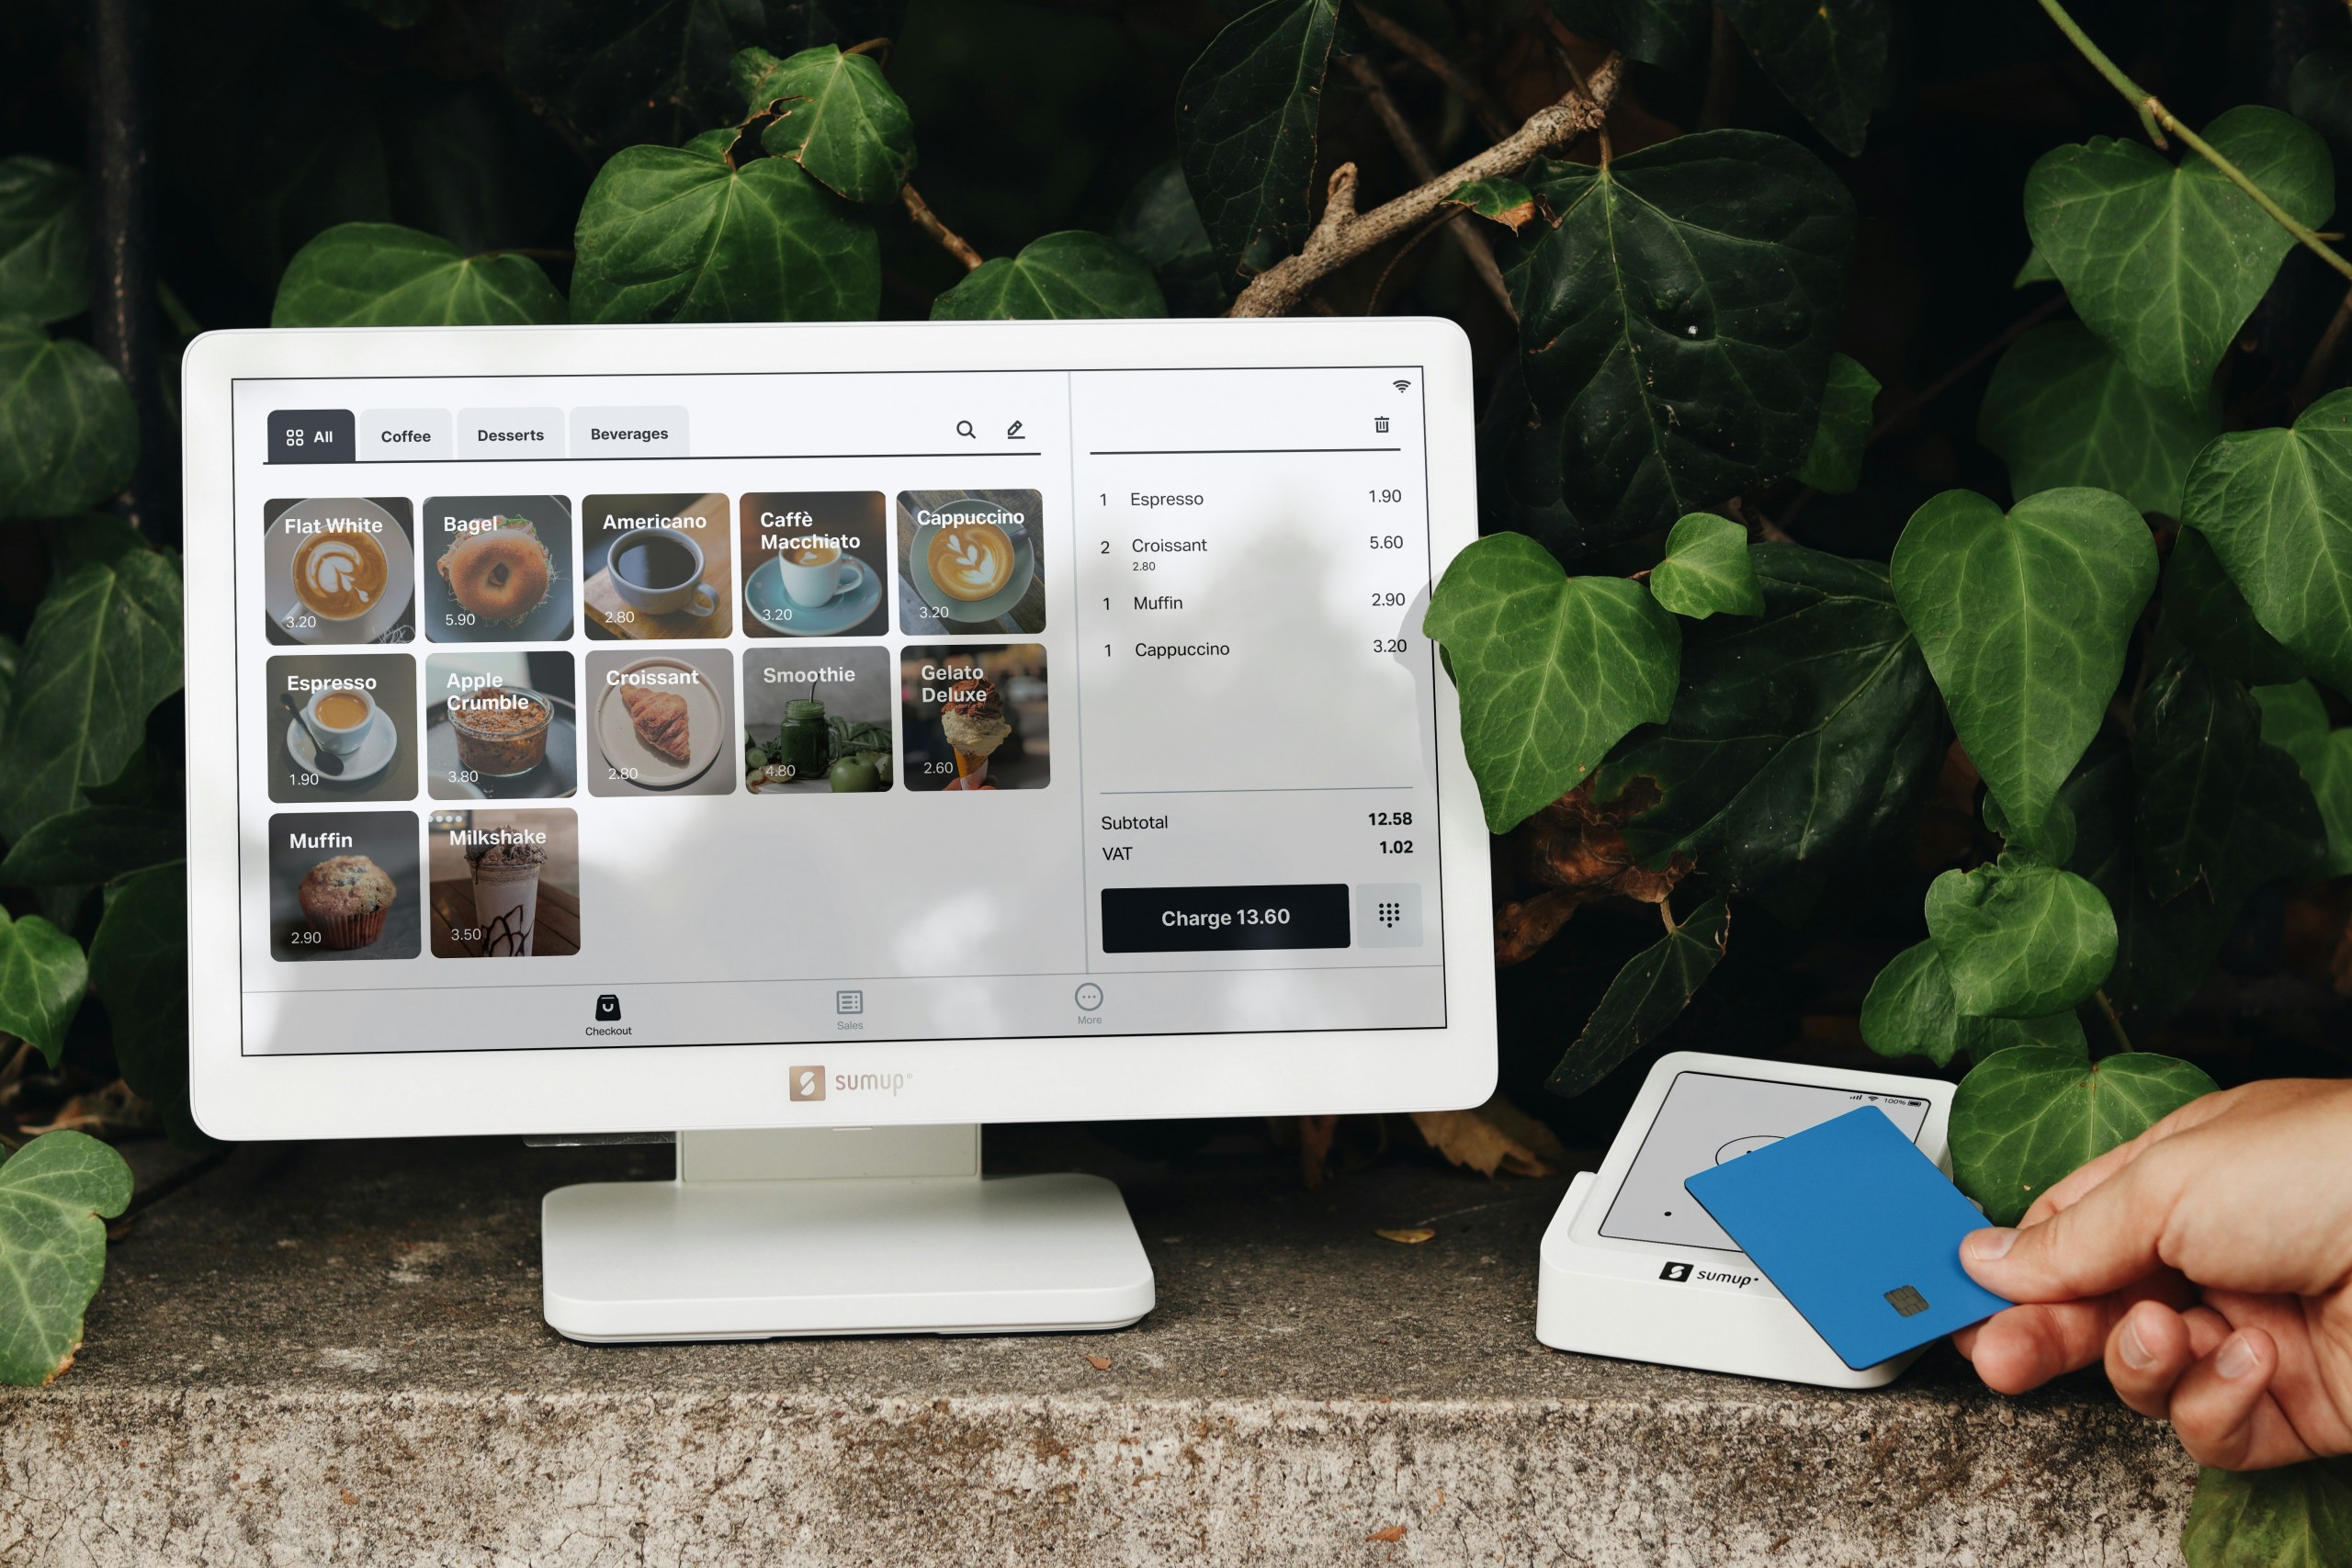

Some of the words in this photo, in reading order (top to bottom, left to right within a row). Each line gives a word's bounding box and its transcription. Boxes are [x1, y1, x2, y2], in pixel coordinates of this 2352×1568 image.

[313, 430, 334, 444] All
[381, 430, 432, 444] Coffee
[477, 429, 545, 442] Desserts
[591, 426, 669, 444] Beverages
[1100, 494, 1107, 506] 1
[1131, 492, 1204, 509] Espresso
[1369, 490, 1402, 503] 1.90
[285, 519, 321, 534] Flat
[324, 517, 383, 533] White
[444, 516, 498, 536] Bagel
[602, 513, 707, 530] Americano
[761, 512, 813, 528] Caffè
[917, 510, 1024, 529] Cappuccino
[761, 534, 861, 549] Macchiato
[1101, 541, 1110, 554] 2
[1132, 538, 1207, 553] Croissant
[1370, 536, 1404, 549] 5.60
[1132, 561, 1156, 571] 2.80
[1102, 598, 1110, 610] 1
[1134, 596, 1182, 610] Muffin
[1372, 593, 1406, 606] 2.90
[605, 612, 635, 623] 2.80
[763, 609, 792, 621] 3.20
[919, 606, 949, 618] 3.20
[286, 616, 316, 628] 3.20
[446, 614, 475, 626] 5.90
[1104, 645, 1112, 657] 1
[1135, 641, 1230, 660] Cappuccino
[1374, 639, 1408, 653] 3.20
[605, 670, 699, 686] Croissant
[763, 667, 855, 684] Smoothie
[922, 665, 984, 681] Gelato
[288, 675, 377, 694] Espresso
[447, 672, 503, 692] Apple
[922, 687, 987, 703] Deluxe
[447, 695, 529, 711] Crumble
[608, 768, 638, 780] 2.80
[765, 764, 796, 777] 4.80
[923, 762, 954, 774] 2.60
[289, 773, 319, 785] 1.90
[448, 771, 479, 783] 3.80
[1102, 816, 1169, 830] Subtotal
[1368, 812, 1413, 826] 12.58
[289, 832, 353, 849] Muffin
[449, 829, 547, 846] Milkshake
[1102, 847, 1133, 861] VAT
[1380, 840, 1414, 854] 1.02
[1161, 910, 1232, 930] Charge
[1237, 908, 1290, 925] 13.60
[291, 931, 322, 944] 2.90
[451, 929, 481, 941] 3.50
[837, 1021, 864, 1031] Sales
[1078, 1015, 1102, 1024] More
[585, 1026, 632, 1036] Checkout
